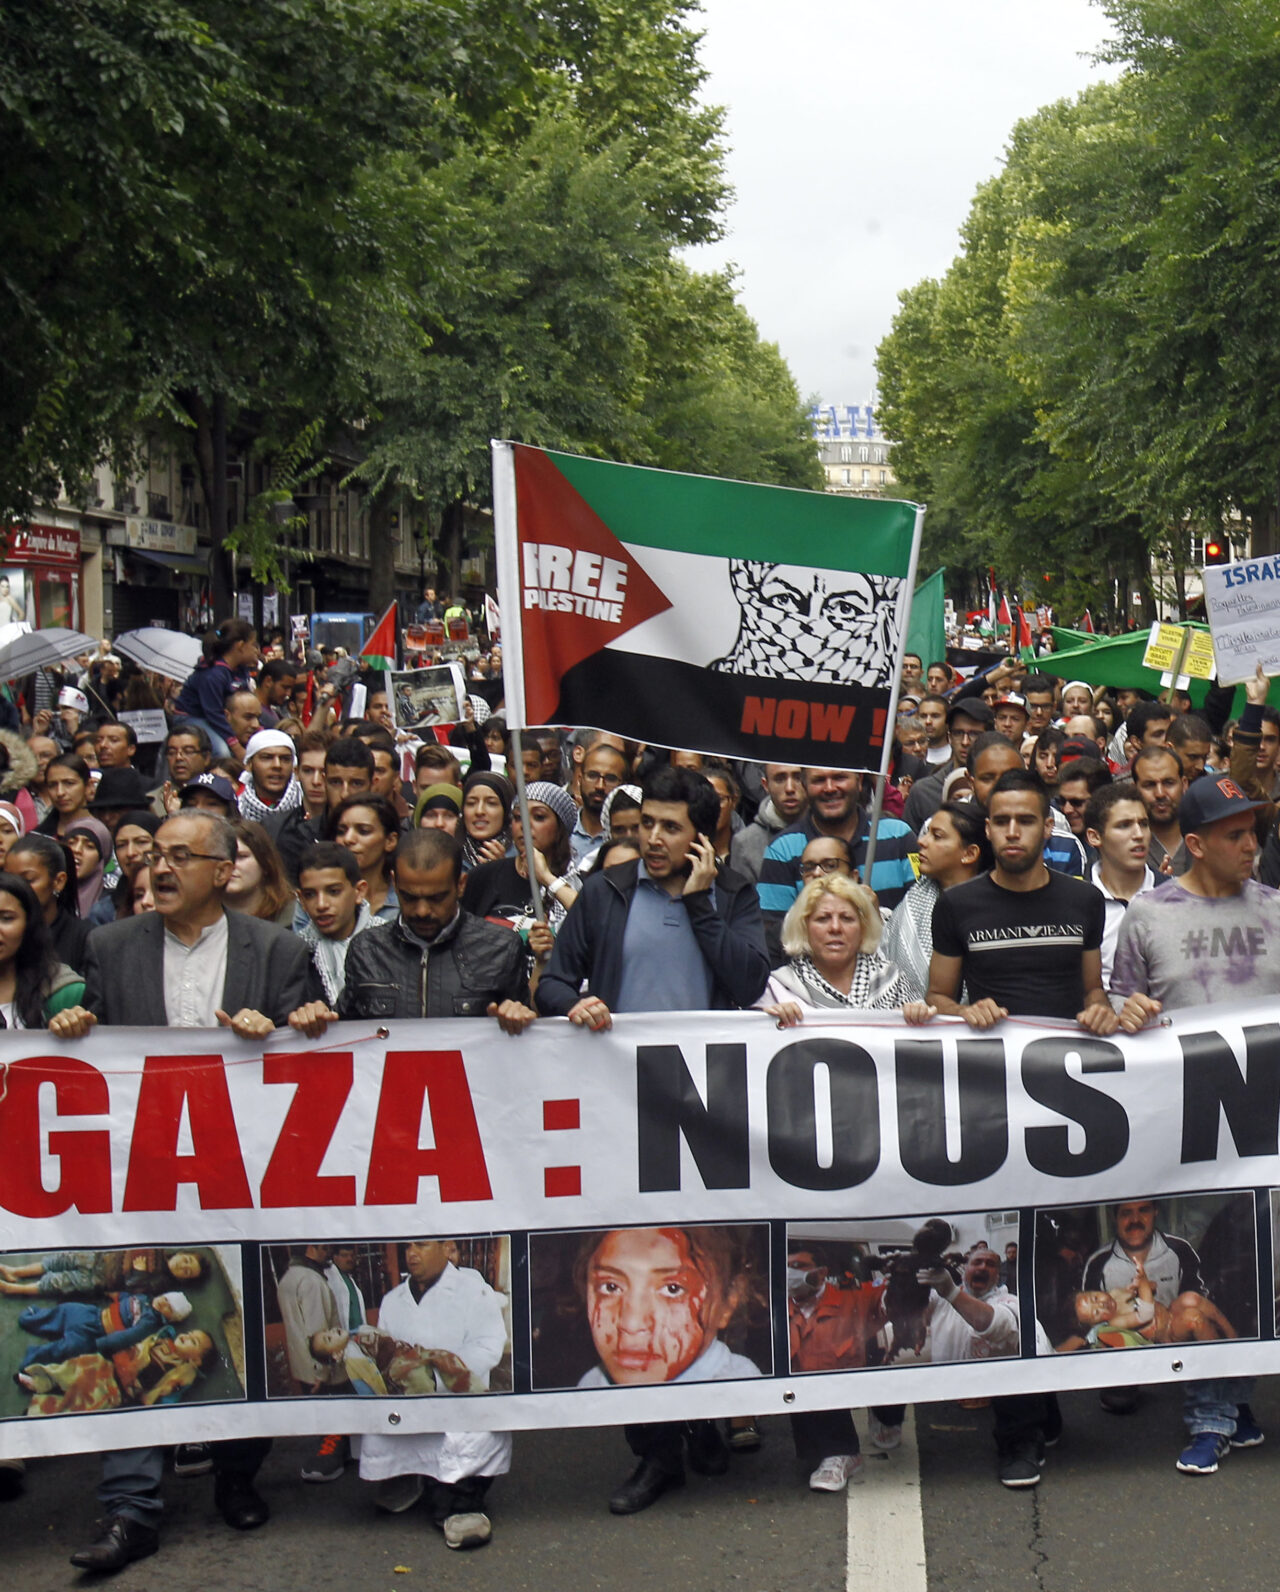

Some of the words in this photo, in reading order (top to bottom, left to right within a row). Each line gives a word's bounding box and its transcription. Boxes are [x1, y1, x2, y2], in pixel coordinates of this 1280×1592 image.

[740, 696, 856, 743] NOW
[869, 708, 887, 747] !
[968, 927, 1022, 943] ARMANI
[1039, 924, 1084, 938] JEANS
[1180, 926, 1268, 959] #ME
[0, 1050, 494, 1219] GAZA
[636, 1037, 1130, 1192] NOUS
